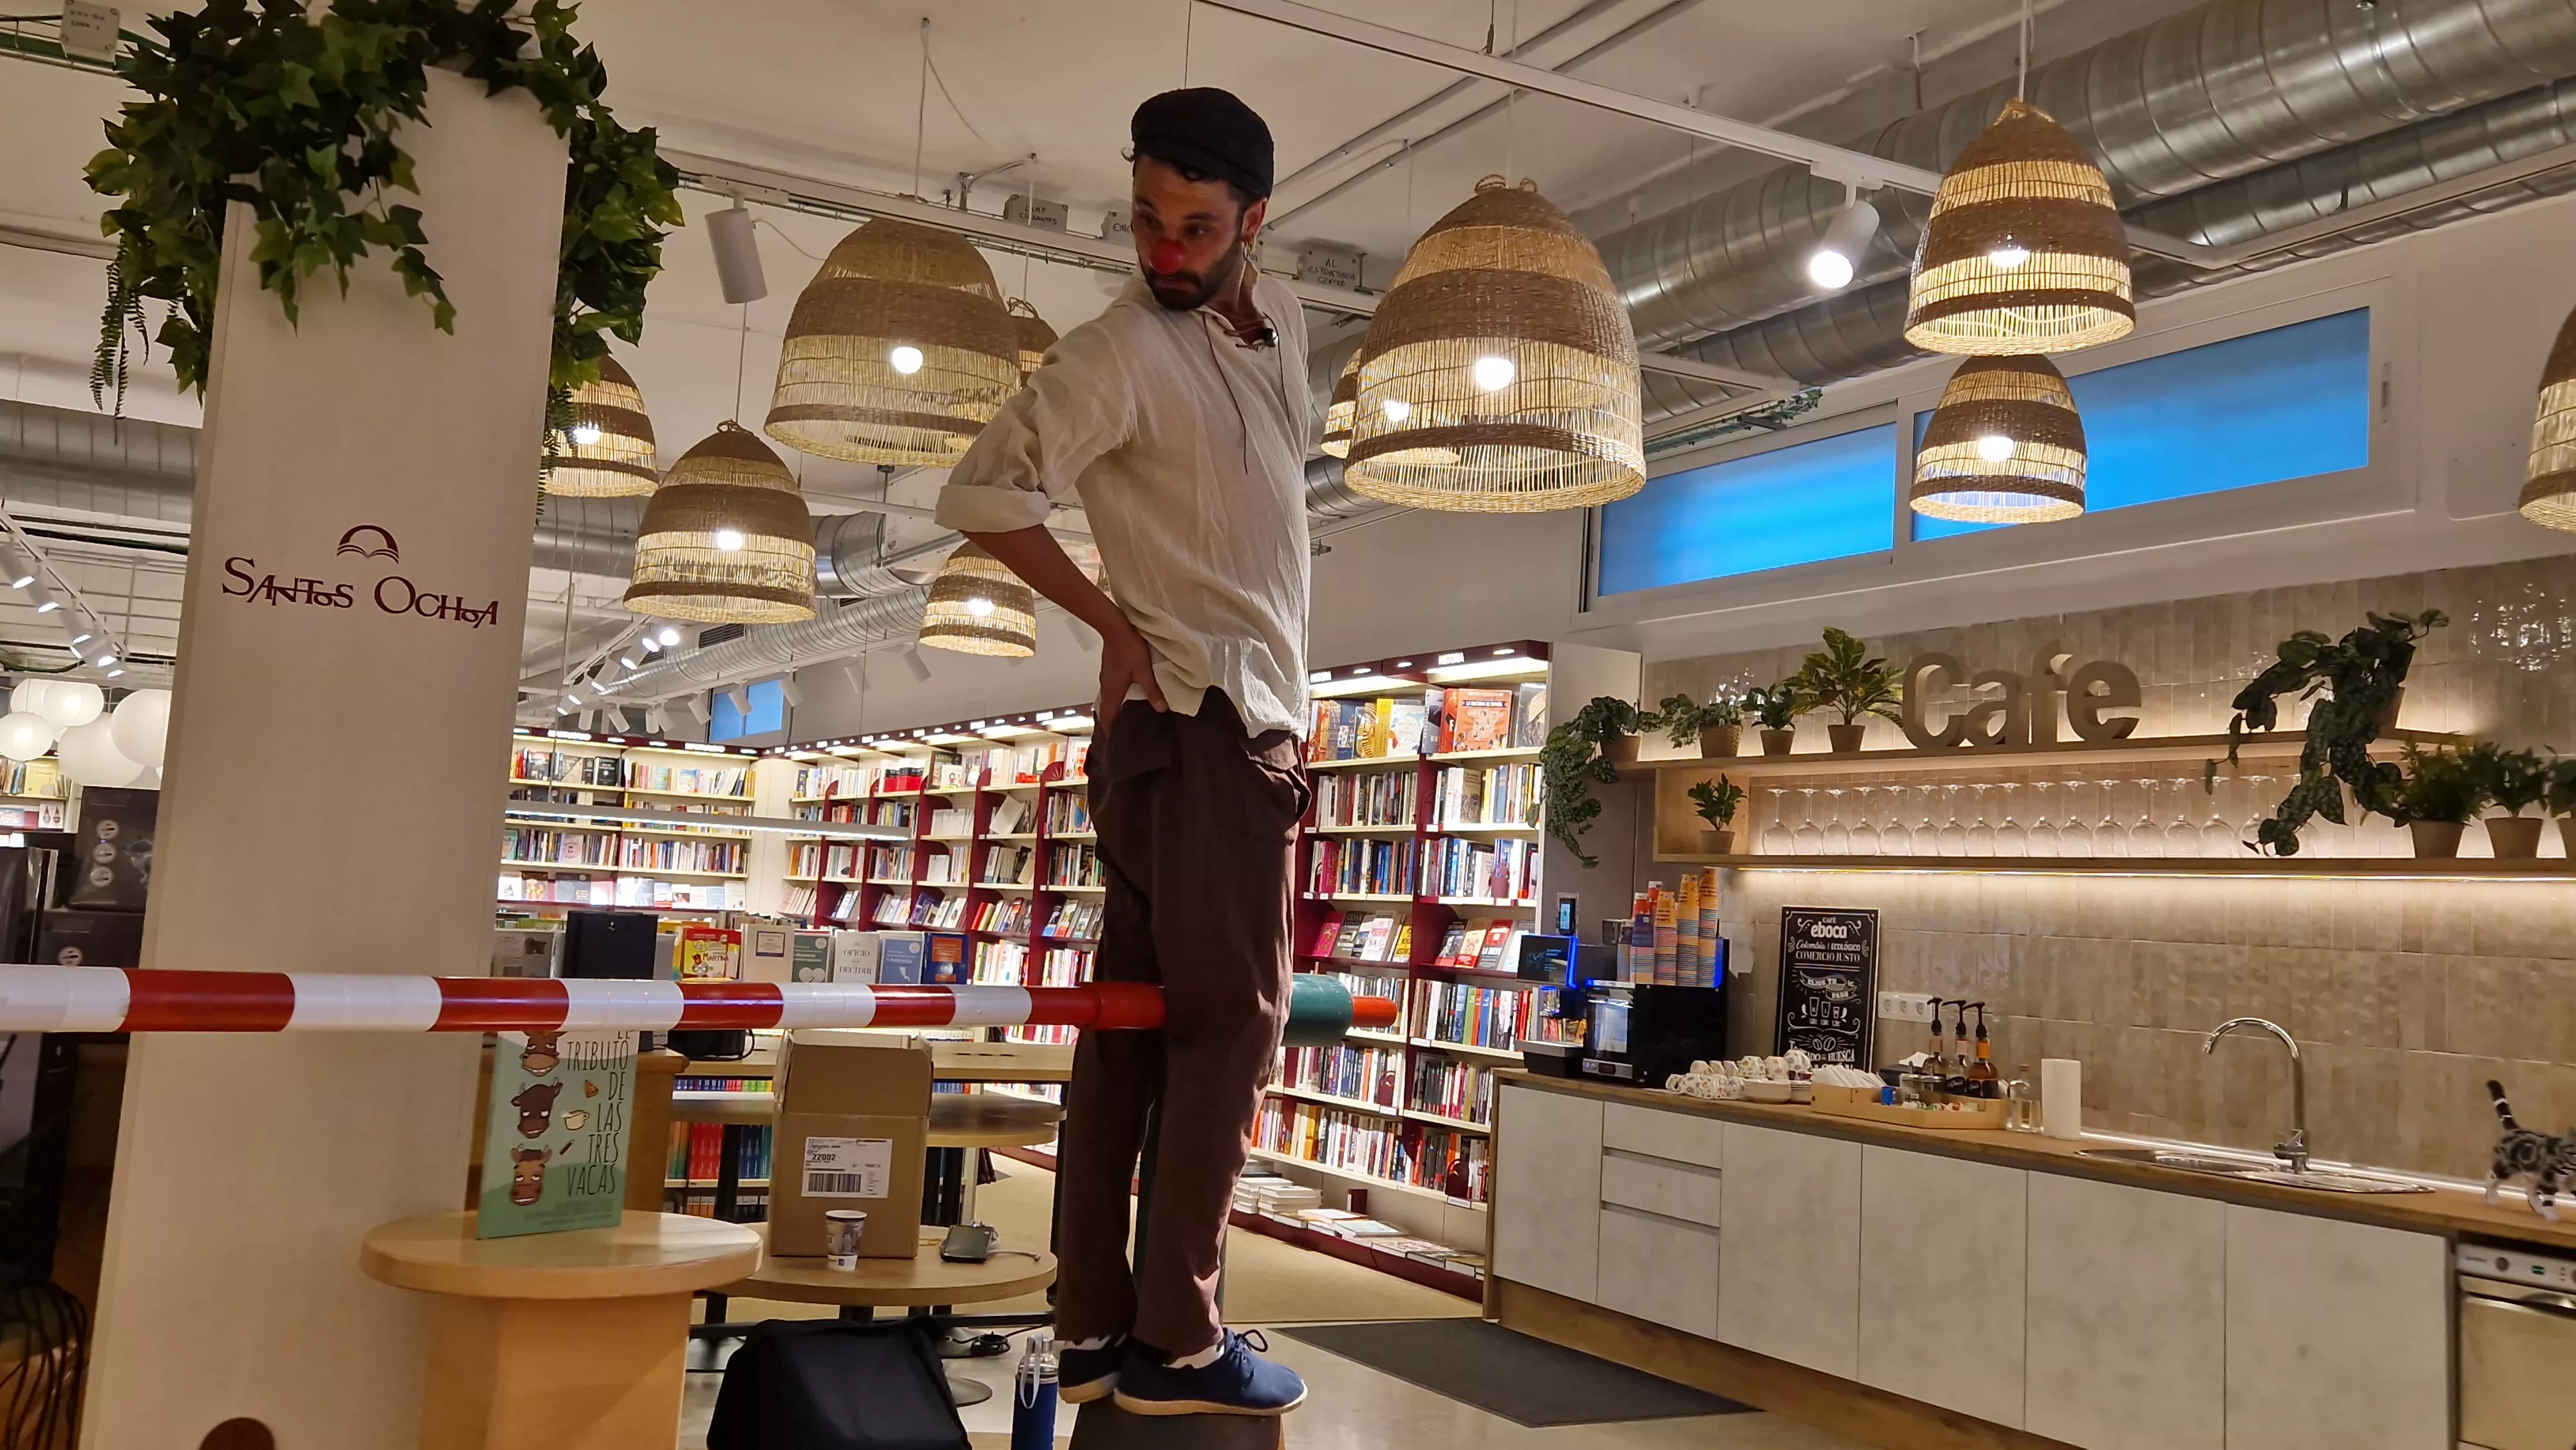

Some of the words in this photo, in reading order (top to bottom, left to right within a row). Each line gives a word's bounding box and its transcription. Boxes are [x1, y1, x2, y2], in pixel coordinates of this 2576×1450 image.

[1902, 639, 2141, 748] Cafe
[1811, 921, 1847, 938] eboca
[1795, 951, 1835, 960] COMERCIO
[1835, 953, 1860, 962] JUSTO
[1796, 939, 1826, 950] Colombia
[839, 966, 872, 974] DECIDIR
[567, 1040, 629, 1071] TRIBUTO
[1828, 1049, 1855, 1062] HUESCA
[609, 1071, 626, 1100] DE
[596, 1101, 623, 1133] LAS
[589, 1133, 620, 1163] TRES
[568, 1163, 616, 1196] VACAS
